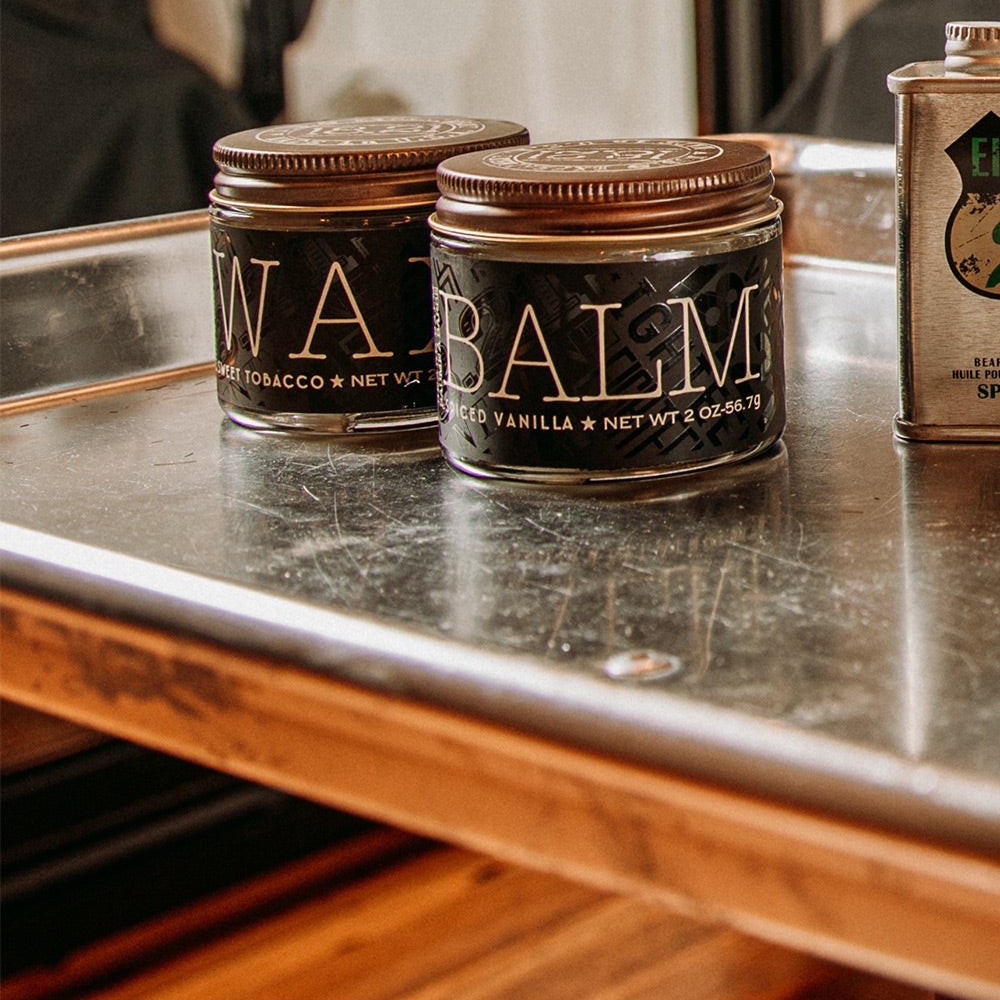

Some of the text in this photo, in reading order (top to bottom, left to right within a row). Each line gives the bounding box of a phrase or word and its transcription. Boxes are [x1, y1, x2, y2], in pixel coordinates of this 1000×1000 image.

[439, 284, 760, 402] BALM
[245, 370, 324, 390] TOBACCO
[351, 373, 389, 388] NET
[393, 370, 423, 386] WT
[952, 370, 980, 379] HUILE
[494, 411, 573, 431] VANILLA
[604, 415, 644, 430] NET
[649, 410, 679, 426] WT
[684, 409, 695, 423] 2
[699, 394, 761, 420] OZ-56.7g
